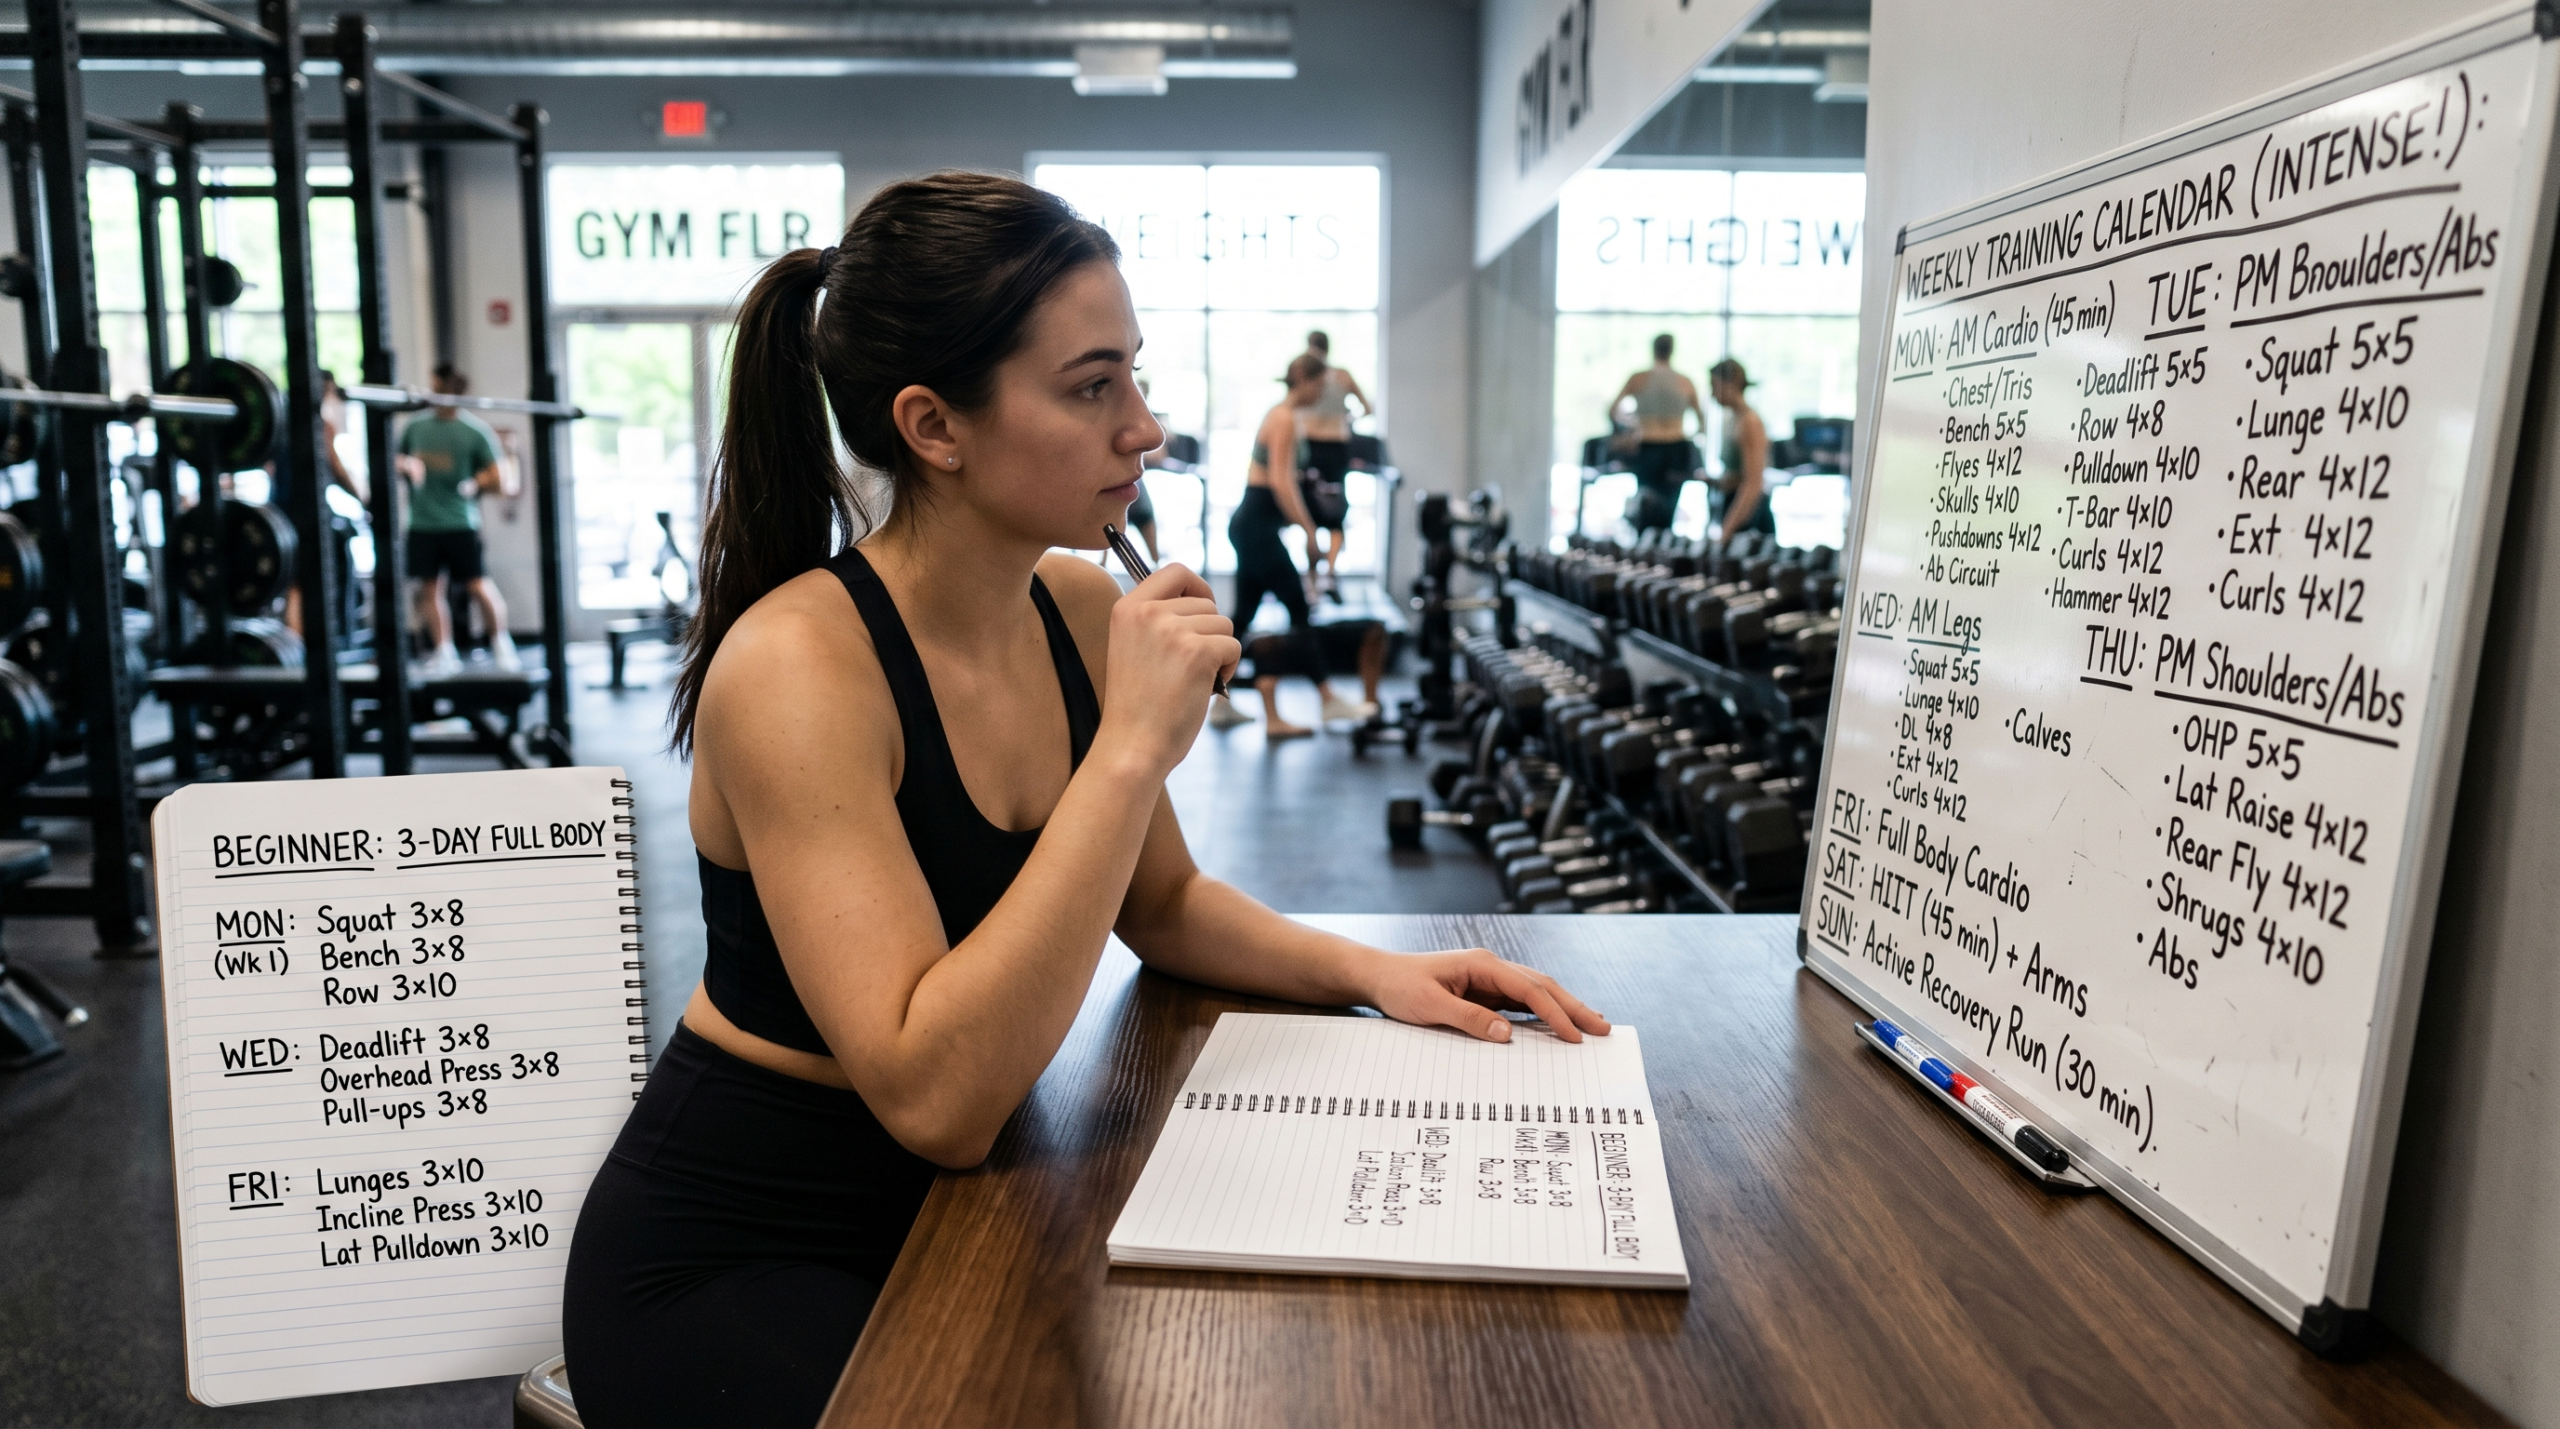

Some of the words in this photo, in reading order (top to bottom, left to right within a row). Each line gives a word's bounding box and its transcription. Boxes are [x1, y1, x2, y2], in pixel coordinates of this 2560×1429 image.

[1908, 242, 1979, 301] WEEKLY
[1987, 210, 2083, 280] TRAINING
[2093, 164, 2236, 252] CALENDAR
[2251, 71, 2488, 219] (INTENSE!):
[576, 211, 690, 259] GYM
[720, 211, 811, 258] FLR
[2148, 262, 2222, 326] TUE:
[2233, 248, 2280, 311] PM
[1894, 325, 1942, 370] MON:
[1947, 315, 1978, 360] AM
[1983, 306, 2038, 353] Cardio
[2084, 353, 2159, 397] Deadlift
[2256, 326, 2340, 396] Squat
[1949, 367, 2032, 409] Chest/Tris
[1945, 413, 1989, 444] Bench
[2078, 408, 2118, 442] Row
[2248, 399, 2325, 455] Lunge
[1941, 450, 1979, 488] Flyes
[2071, 449, 2148, 485] Pulldown
[2239, 454, 2305, 499] Rear
[1936, 485, 1979, 514] Skulls
[2066, 495, 2120, 528] T-Bar
[1930, 519, 2003, 550] Pushdowns
[2059, 537, 2107, 571] Curls
[2230, 513, 2281, 555] Ext
[1925, 554, 1944, 582] Ab
[1949, 557, 2000, 587] Circuit
[2220, 568, 2286, 615] Curls
[2052, 577, 2122, 613] Hammer
[1860, 592, 1903, 629] WED:
[1908, 597, 1938, 635] AM
[1943, 600, 1982, 656] Legs
[1909, 648, 1947, 685] Squat
[2086, 625, 2146, 677] THU:
[2155, 634, 2196, 687] PM
[2203, 641, 2405, 728] Shoulders/Abs
[1905, 684, 1942, 718] Lunge
[1901, 713, 1918, 741] DL
[2013, 708, 2071, 757] Calves
[2184, 715, 2238, 760] OHP
[1897, 745, 1921, 773] Ext
[1893, 774, 1928, 808] Curls
[2176, 764, 2218, 811] Lat
[2226, 776, 2294, 839] Raise
[213, 829, 382, 868] BEGINNER:
[398, 826, 481, 858] 3-DAY
[491, 824, 544, 852] FULL
[550, 820, 606, 848] BODY
[1832, 789, 1871, 835] FRI:
[1878, 808, 1910, 856] Full
[1914, 824, 1958, 897] Body
[1965, 845, 2029, 912] Cardio
[2167, 816, 2223, 872] Rear
[2230, 840, 2271, 913] Fly
[216, 909, 295, 940] MON:
[317, 903, 396, 943] Squat
[1824, 842, 1864, 888] SAT:
[1870, 863, 1918, 920] HIIT
[1922, 888, 1954, 940] (45
[1957, 916, 1998, 974] min)
[2007, 944, 2018, 969] +
[2023, 942, 2088, 1018] Arms
[2157, 871, 2245, 959] Shrugs
[320, 939, 400, 971] Bench
[2148, 927, 2198, 990] Abs
[323, 977, 378, 1006] Row
[1817, 894, 1858, 946] SUN:
[1863, 920, 1915, 985] Active
[1920, 952, 2001, 1057] Recovery
[2006, 1005, 2046, 1074] Run
[2056, 1033, 2095, 1099] (30
[219, 1038, 300, 1070] WED:
[319, 1027, 426, 1062] Deadlift
[321, 1060, 432, 1093] Overhead
[441, 1058, 502, 1084] Press
[323, 1097, 425, 1130] Pull-ups
[228, 1171, 290, 1203] FRI:
[317, 1168, 410, 1203] Lunges
[316, 1203, 404, 1232] Incline
[413, 1196, 475, 1224] Press
[321, 1238, 362, 1267] Lat
[372, 1233, 480, 1262] Pulldown
